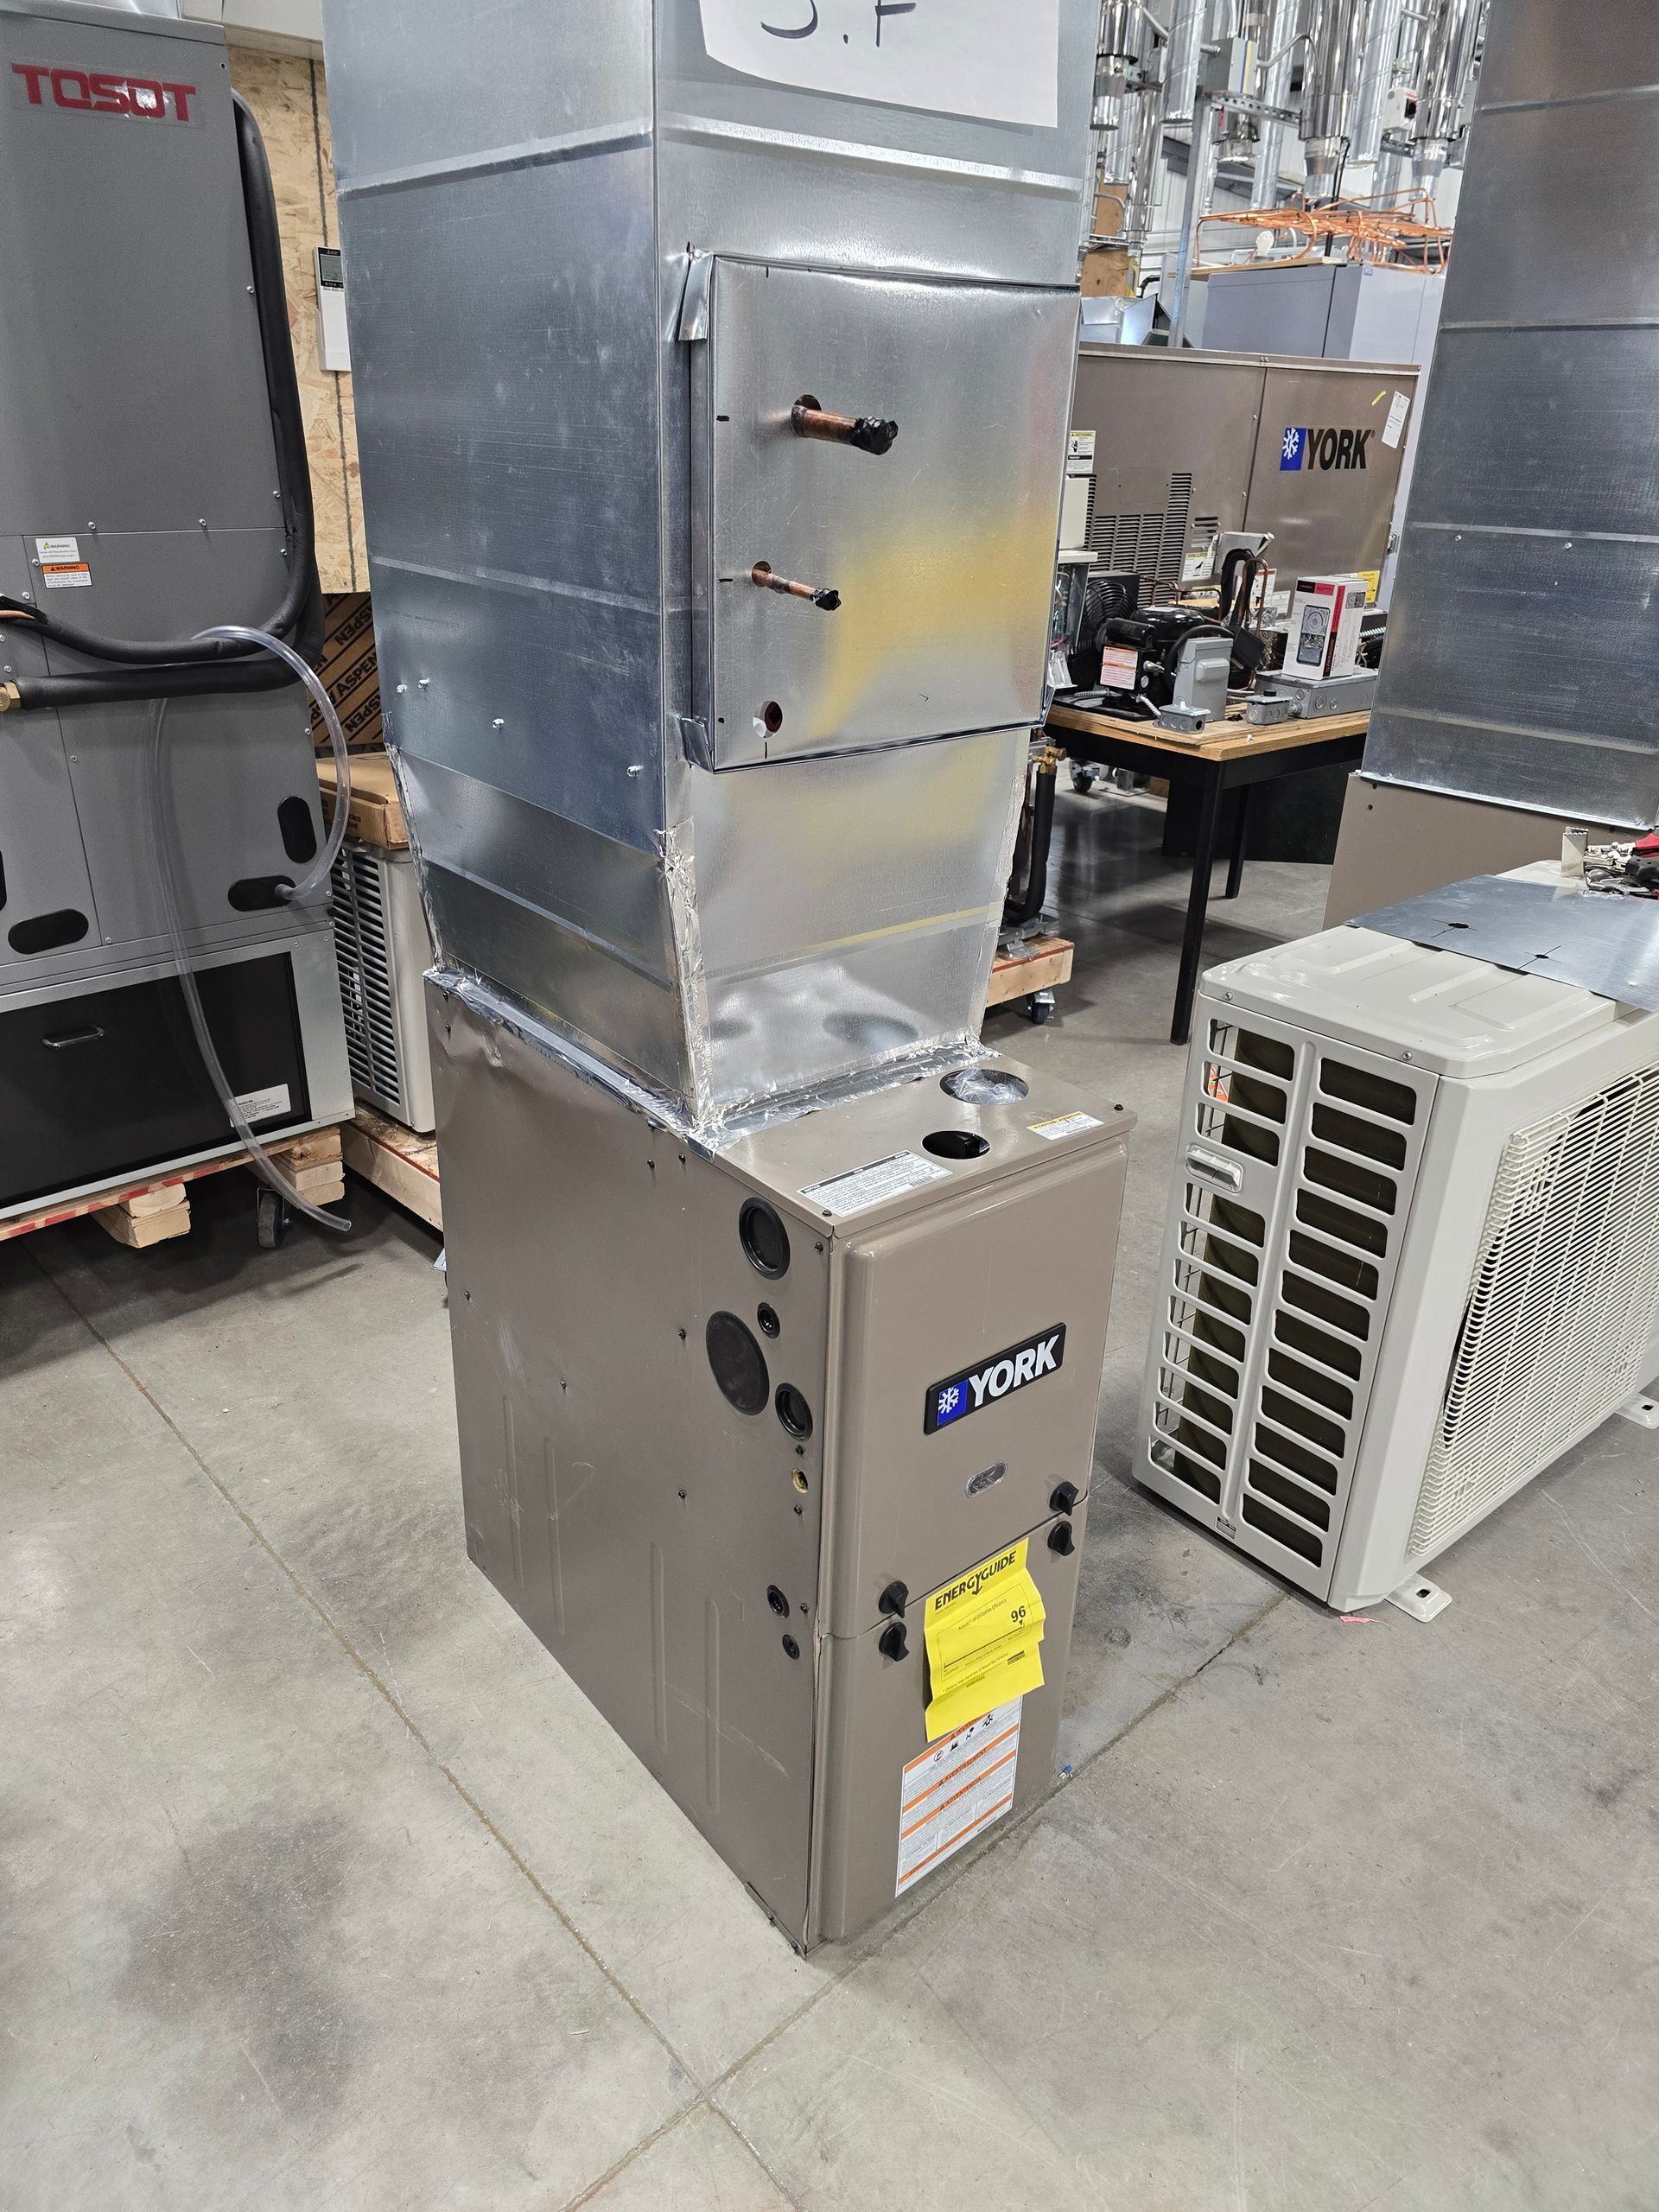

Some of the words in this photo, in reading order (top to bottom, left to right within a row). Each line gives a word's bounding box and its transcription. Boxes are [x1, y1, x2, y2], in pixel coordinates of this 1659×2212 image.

[11, 62, 196, 122] TOSOT
[969, 1334, 1059, 1408] YORK
[935, 1550, 1017, 1611] ENERGYGUIDE
[1011, 1605, 1027, 1623] 96
